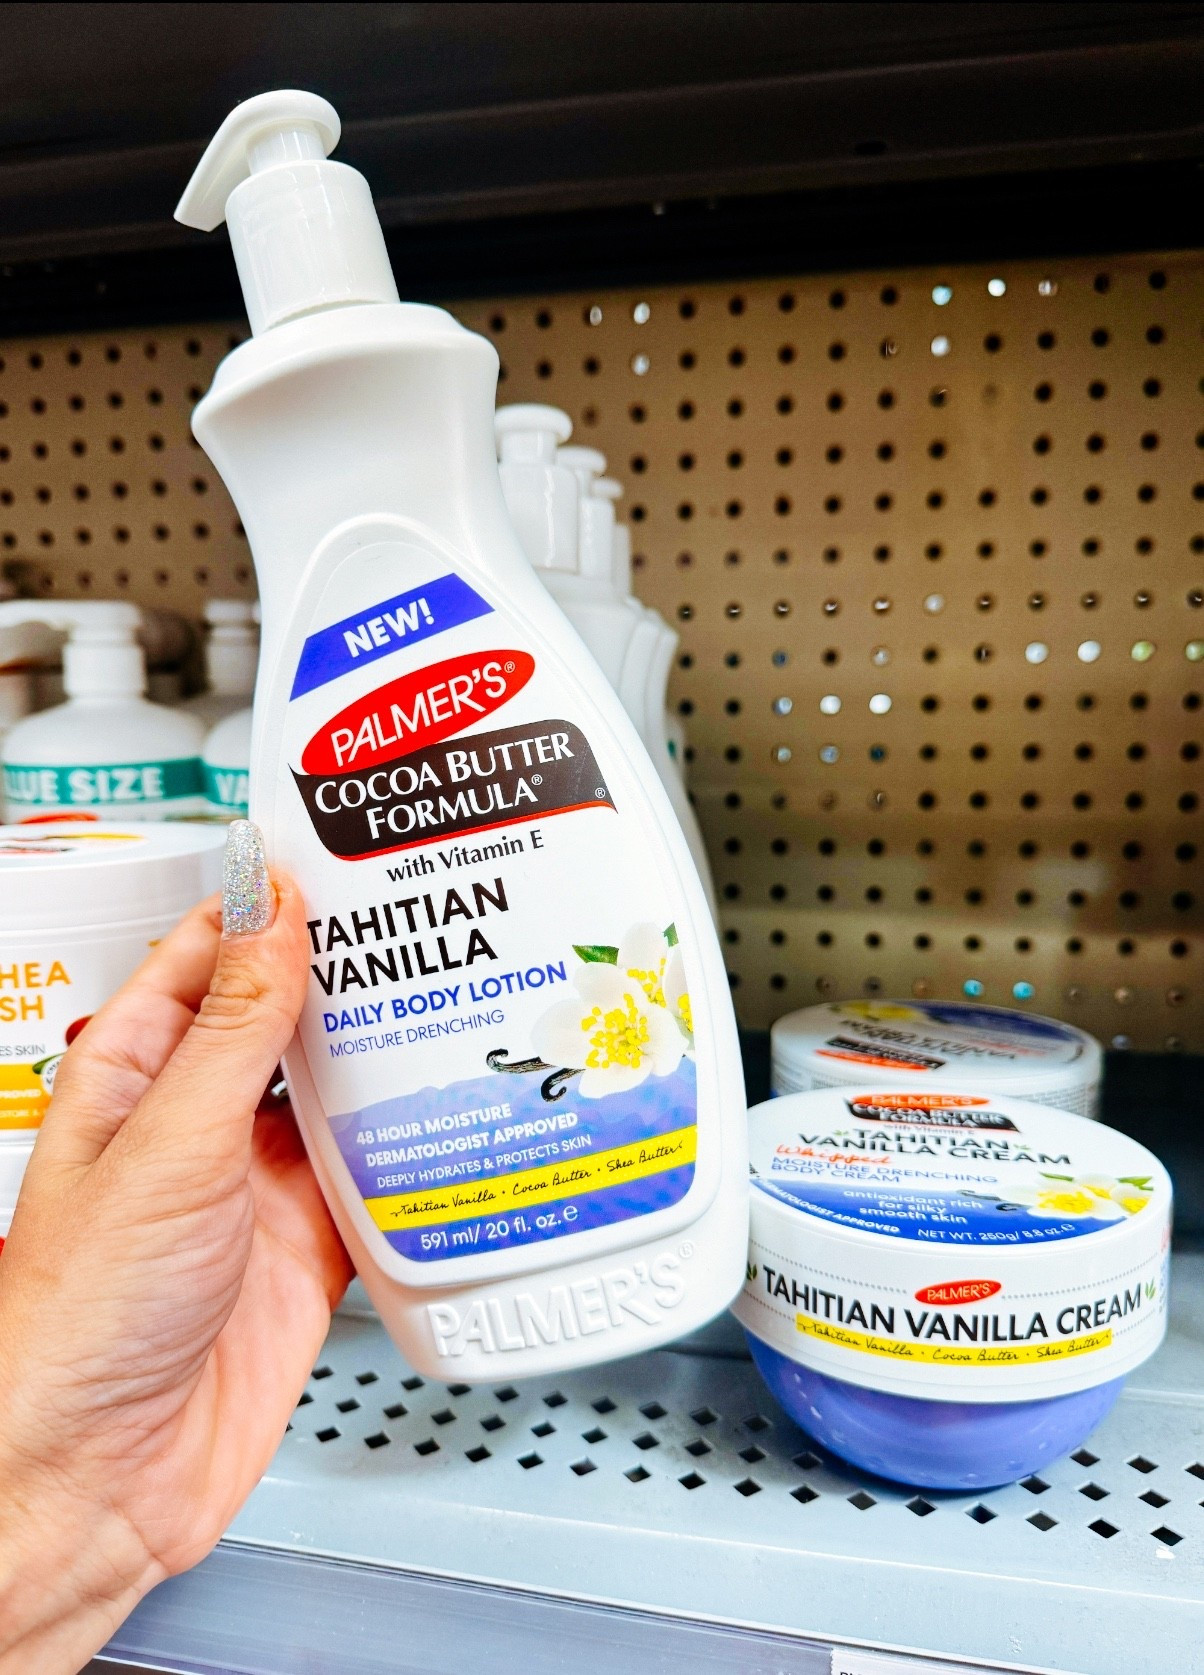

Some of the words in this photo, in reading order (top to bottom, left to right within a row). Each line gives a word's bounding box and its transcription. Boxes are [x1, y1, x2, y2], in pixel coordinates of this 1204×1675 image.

[342, 597, 435, 658] NEW!
[68, 766, 165, 801] SIZE
[314, 761, 442, 814] COCOA
[445, 731, 576, 783] BUTTER
[386, 854, 436, 882] with
[437, 835, 525, 870] Vitamin
[529, 829, 545, 850] E
[306, 877, 510, 955] TAHITIAN
[311, 928, 499, 997] VANILLA
[323, 1001, 385, 1033] DAILY
[392, 984, 462, 1020] BODY
[468, 960, 568, 1001] LOTION
[15, 1044, 46, 1056] SKIN
[329, 1029, 404, 1058] MOISTURE
[406, 1009, 505, 1043] DRENCHING
[356, 1129, 375, 1146] 48
[376, 1122, 424, 1143] HOUR
[425, 1102, 513, 1136] MOISTURE
[365, 1131, 490, 1168] DERMATOLOGIST
[493, 1112, 579, 1146] APPROVED
[853, 1127, 1009, 1149] TAHITIAN
[377, 1172, 415, 1189] DEEPLY
[419, 1161, 481, 1183] HYDRATES
[483, 1157, 495, 1169] &
[496, 1143, 560, 1167] PROTECTS
[562, 1134, 592, 1151] SKIN
[775, 1144, 892, 1165] Whipped
[798, 1132, 937, 1156] VANILLA
[949, 1146, 1072, 1165] CREAM
[394, 1200, 450, 1217] Tahitian
[452, 1189, 497, 1208] Vanilla
[512, 1180, 548, 1196] Cocoa
[552, 1169, 593, 1187] Butter
[606, 1157, 635, 1173] Shea
[638, 1144, 679, 1164] Butter
[771, 1164, 823, 1176] BODY
[831, 1169, 901, 1183] CREAM
[772, 1156, 870, 1173] MOISTURE
[877, 1166, 998, 1184] DRENCHING
[843, 1189, 946, 1206] antioxidant
[950, 1198, 983, 1209] rich
[859, 1206, 926, 1220] smooth
[931, 1211, 968, 1224] skin
[878, 1200, 904, 1209] for
[906, 1202, 948, 1214] silky
[420, 1230, 449, 1250] 591
[452, 1223, 482, 1245] ml/
[487, 1220, 510, 1239] 20
[514, 1216, 532, 1234] fl.
[539, 1213, 562, 1228] oz.
[832, 1212, 900, 1233] APPROVED
[918, 1227, 947, 1239] NET
[949, 1230, 977, 1241] WT.
[761, 1263, 896, 1334] TAHITIAN
[904, 1309, 1048, 1343] VANILLA
[1055, 1282, 1142, 1334] CREAM
[927, 1282, 991, 1302] PALMER'S
[812, 1323, 861, 1347] Tahitian
[865, 1337, 914, 1357] Vanilla
[932, 1348, 972, 1361] Cocoa
[976, 1348, 1020, 1362] Butter
[1036, 1344, 1063, 1359] Shea
[1066, 1336, 1104, 1355] Butter
